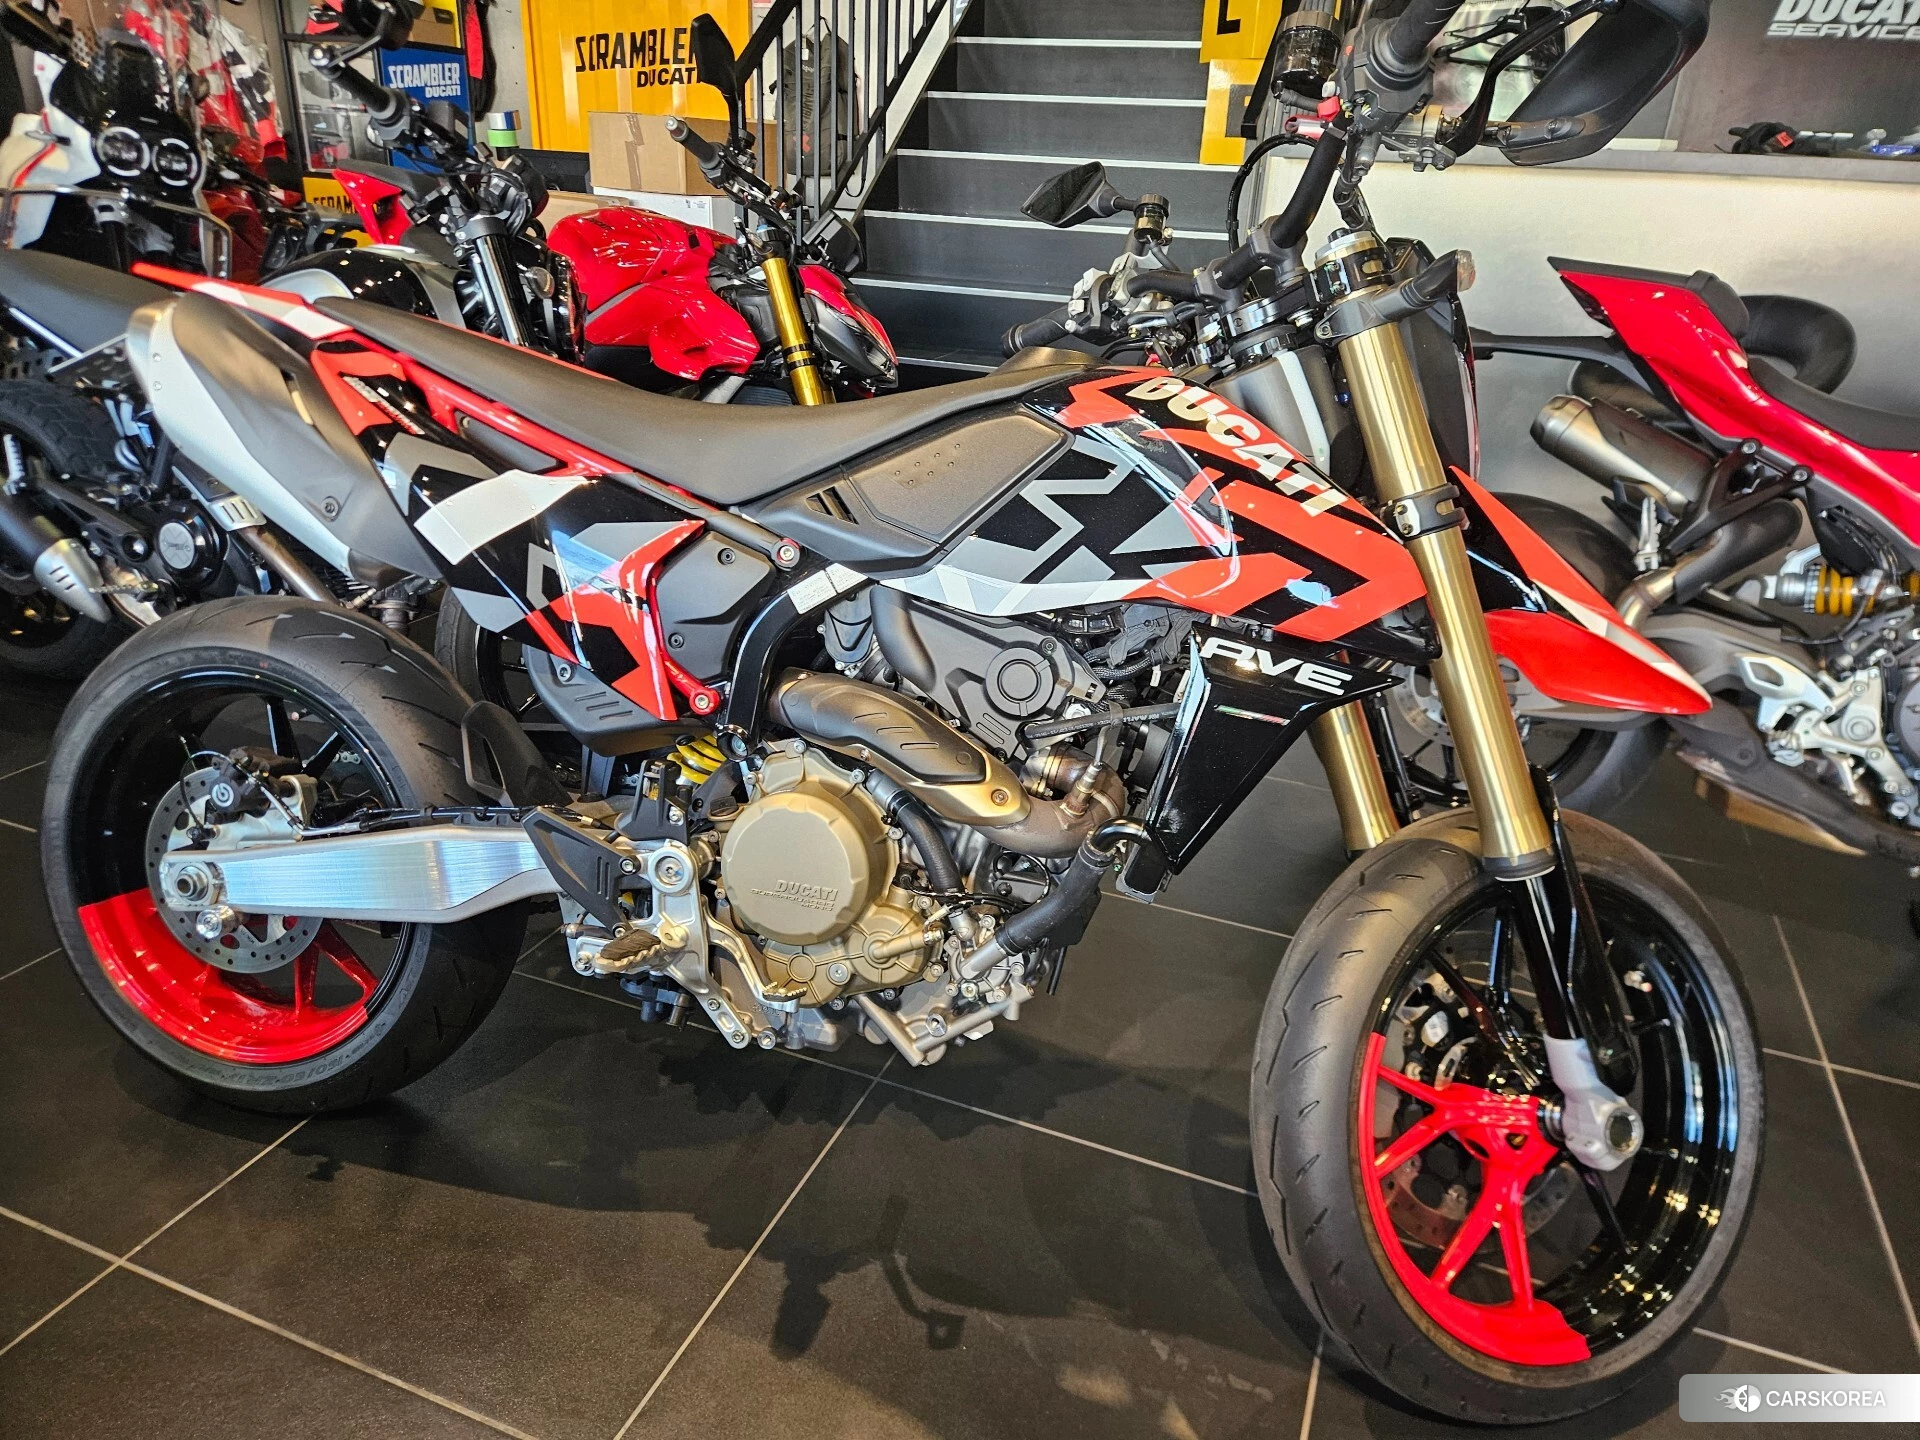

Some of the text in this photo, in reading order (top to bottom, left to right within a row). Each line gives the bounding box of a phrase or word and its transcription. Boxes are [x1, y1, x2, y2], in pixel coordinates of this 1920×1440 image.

[388, 63, 460, 89] SCRAMBLER
[425, 85, 462, 98] DUCATI
[1125, 376, 1349, 517] DUCATI
[775, 879, 839, 902] DUCATI
